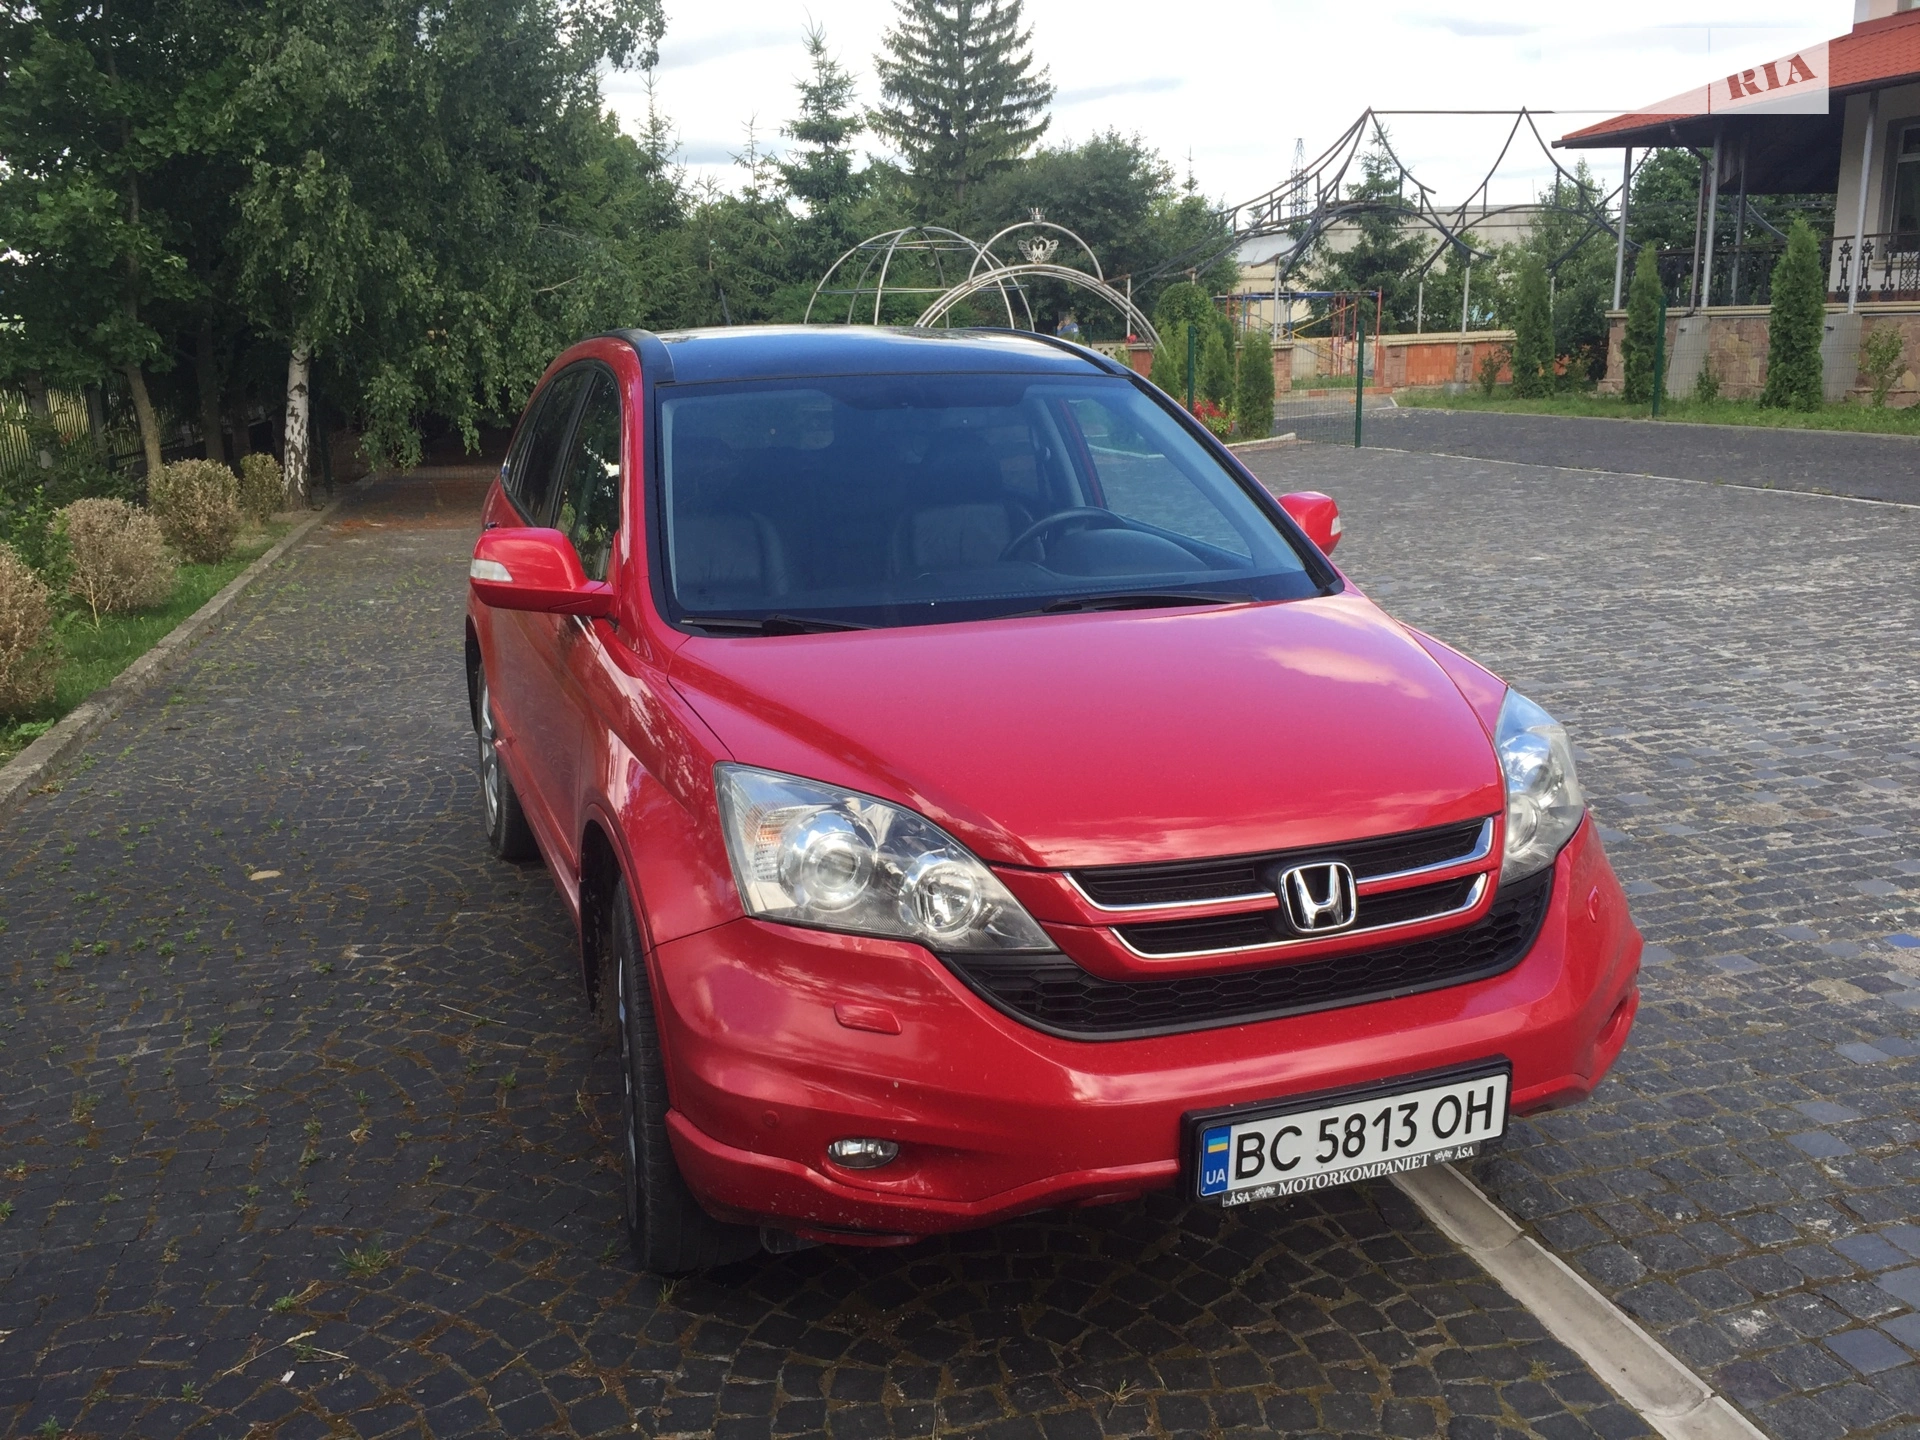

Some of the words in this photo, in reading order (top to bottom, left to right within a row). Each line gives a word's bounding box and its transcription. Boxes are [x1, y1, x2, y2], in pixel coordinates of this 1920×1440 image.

[1235, 1125, 1302, 1180] BC
[1316, 1102, 1419, 1163] 5813
[1432, 1085, 1495, 1139] OH
[1206, 1168, 1226, 1185] UA
[1229, 1190, 1251, 1206] ÅSA
[1278, 1153, 1431, 1196] MOTORKOMPANIET
[1454, 1146, 1474, 1160] ÅSA
